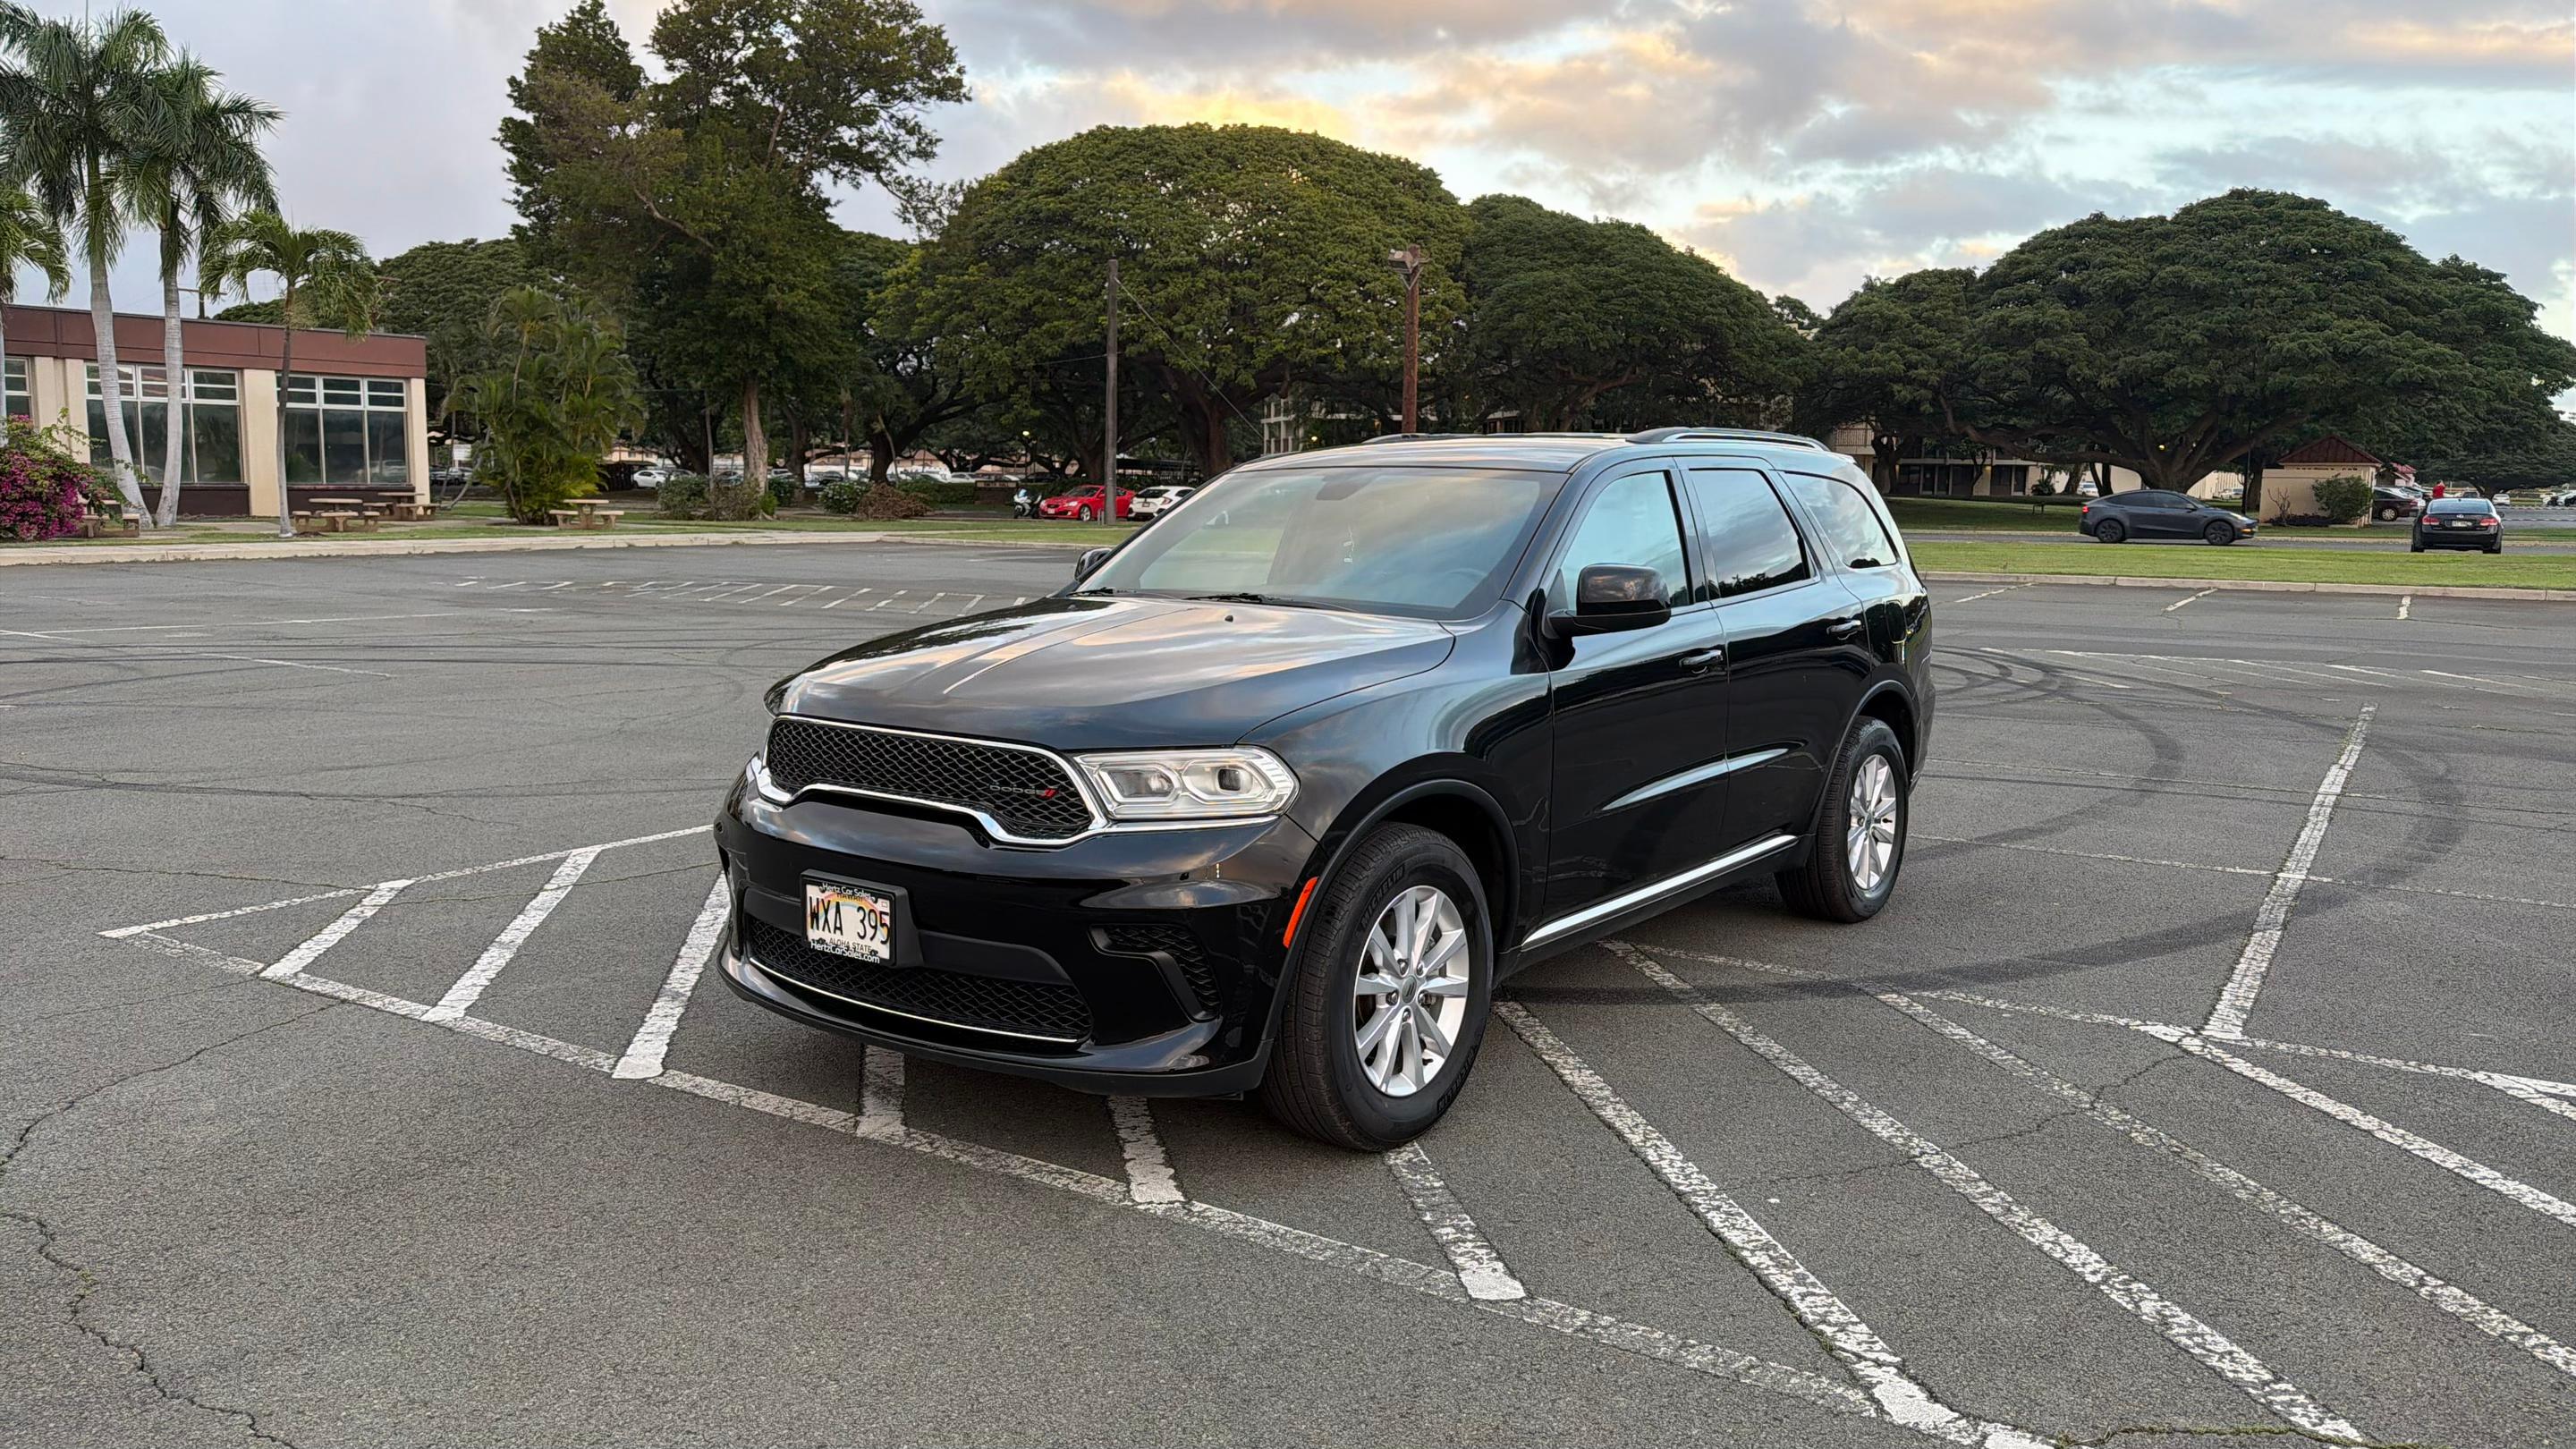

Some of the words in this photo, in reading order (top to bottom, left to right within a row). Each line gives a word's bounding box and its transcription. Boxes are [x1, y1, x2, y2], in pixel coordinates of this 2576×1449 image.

[990, 784, 1046, 795] DODGE
[823, 882, 841, 893] Hertz
[841, 886, 853, 895] Car
[853, 888, 871, 899] Sales
[1360, 864, 1404, 928] MICHELIN
[809, 895, 843, 936] WXA
[856, 906, 889, 945] 395
[810, 940, 880, 963] HertzCarSales.com
[829, 937, 851, 948] ALOHA
[852, 942, 872, 953] STATE
